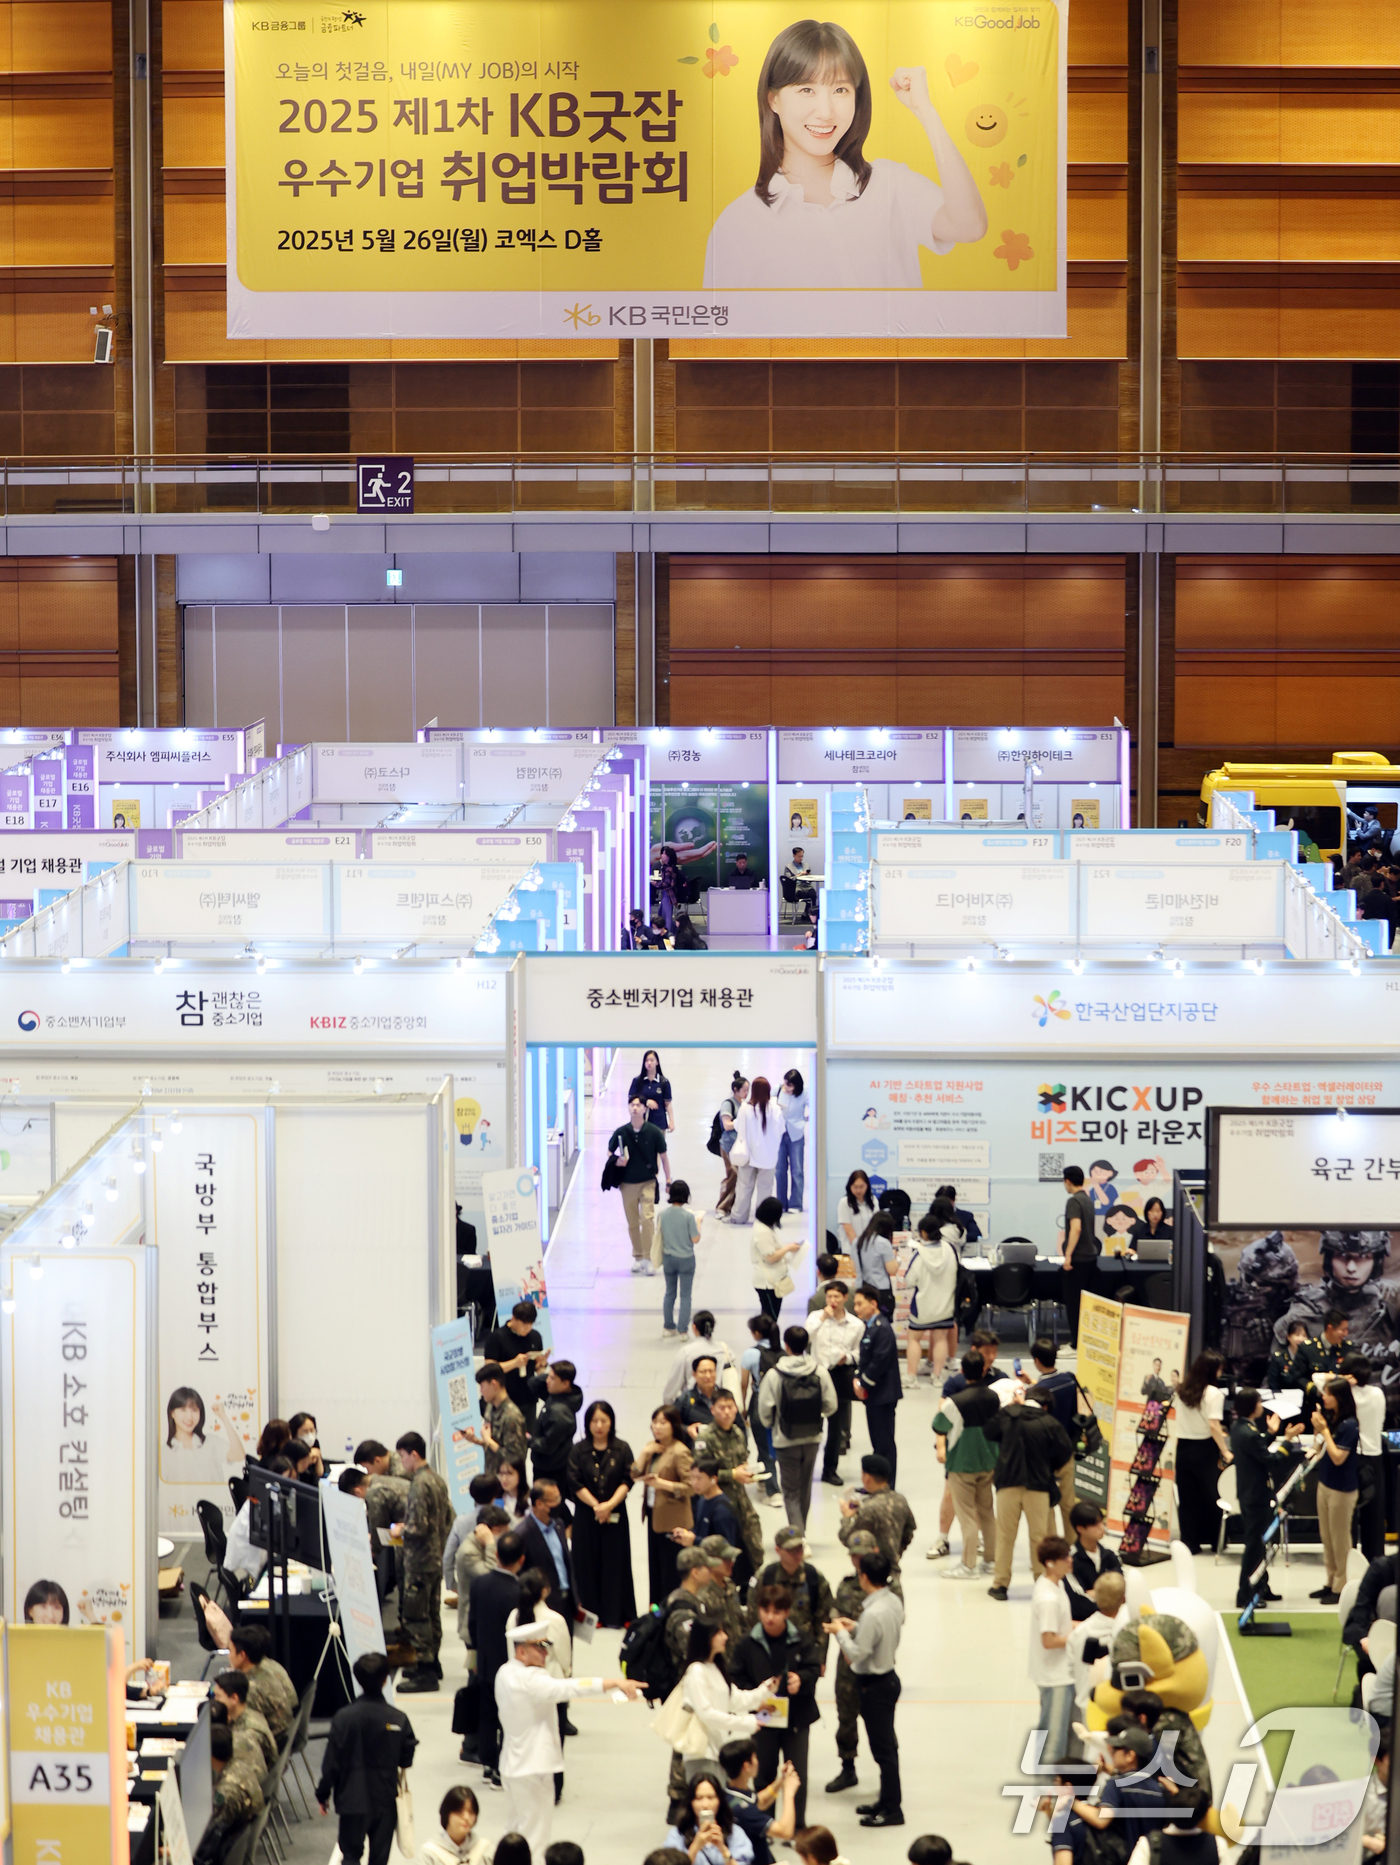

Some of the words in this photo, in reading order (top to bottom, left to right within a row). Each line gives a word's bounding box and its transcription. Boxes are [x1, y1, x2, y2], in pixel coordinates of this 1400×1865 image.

[276, 62, 327, 81] 오늘의
[336, 62, 393, 82] 첫걸음,
[400, 61, 472, 81] 내일(MY
[478, 61, 538, 81] JOB)의
[545, 61, 579, 81] 시작
[278, 99, 378, 134] 2025
[393, 97, 494, 136] 제1차
[509, 90, 683, 143] KB굿잡
[278, 159, 423, 199] 우수기업
[440, 151, 688, 205] 취업박람회
[278, 229, 354, 251] 2025년
[362, 229, 395, 252] 5월
[404, 229, 488, 252] 26일(월)
[495, 229, 557, 251] 코엑스
[565, 228, 603, 252] D홀
[398, 471, 411, 494] 2
[387, 497, 412, 507] EXIT
[106, 751, 146, 762] 주식회사
[150, 751, 211, 762] 엠피씨플러스
[824, 750, 897, 761] 세나테크코리아
[72, 783, 89, 791] E16
[40, 800, 57, 808] E17
[6, 816, 24, 825] E18
[335, 837, 350, 845] E21
[1226, 838, 1241, 846] F20
[11, 858, 37, 874] 기업
[41, 858, 82, 874] 채용관
[477, 980, 497, 990] H12
[212, 992, 262, 1010] 괜찮은
[586, 988, 693, 1009] 중소벤처기업
[700, 988, 754, 1009] 채용관
[176, 990, 208, 1027] 참
[1075, 1002, 1218, 1022] 한국산업단지공단
[46, 1015, 127, 1029] 중소벤처기업부
[212, 1012, 263, 1027] 중소기업
[349, 1015, 427, 1030] 중소기업중앙회
[870, 1081, 881, 1089] AI
[884, 1080, 902, 1090] 기반
[905, 1080, 942, 1091] 스타트업
[946, 1080, 983, 1091] 지원사업
[1252, 1082, 1270, 1092] 우수
[936, 1094, 964, 1104] 서비스
[1071, 1086, 1203, 1112] KICXUP
[1262, 1095, 1299, 1105] 함께하는
[1302, 1095, 1320, 1105] 취업
[1324, 1095, 1332, 1105] 및
[1336, 1095, 1354, 1105] 창업
[1357, 1095, 1376, 1105] 상담
[1031, 1119, 1128, 1145] 비즈모아
[1311, 1157, 1354, 1181] 육군
[195, 1154, 217, 1235] 국방부
[196, 1252, 219, 1361] 통합부스
[62, 1322, 87, 1361] KB
[63, 1373, 89, 1428] 소호
[59, 1441, 88, 1519] 컨설팅
[46, 1682, 72, 1698] KB
[26, 1704, 93, 1724] 우수기업
[34, 1727, 85, 1748] 채용관
[30, 1764, 93, 1792] A35
